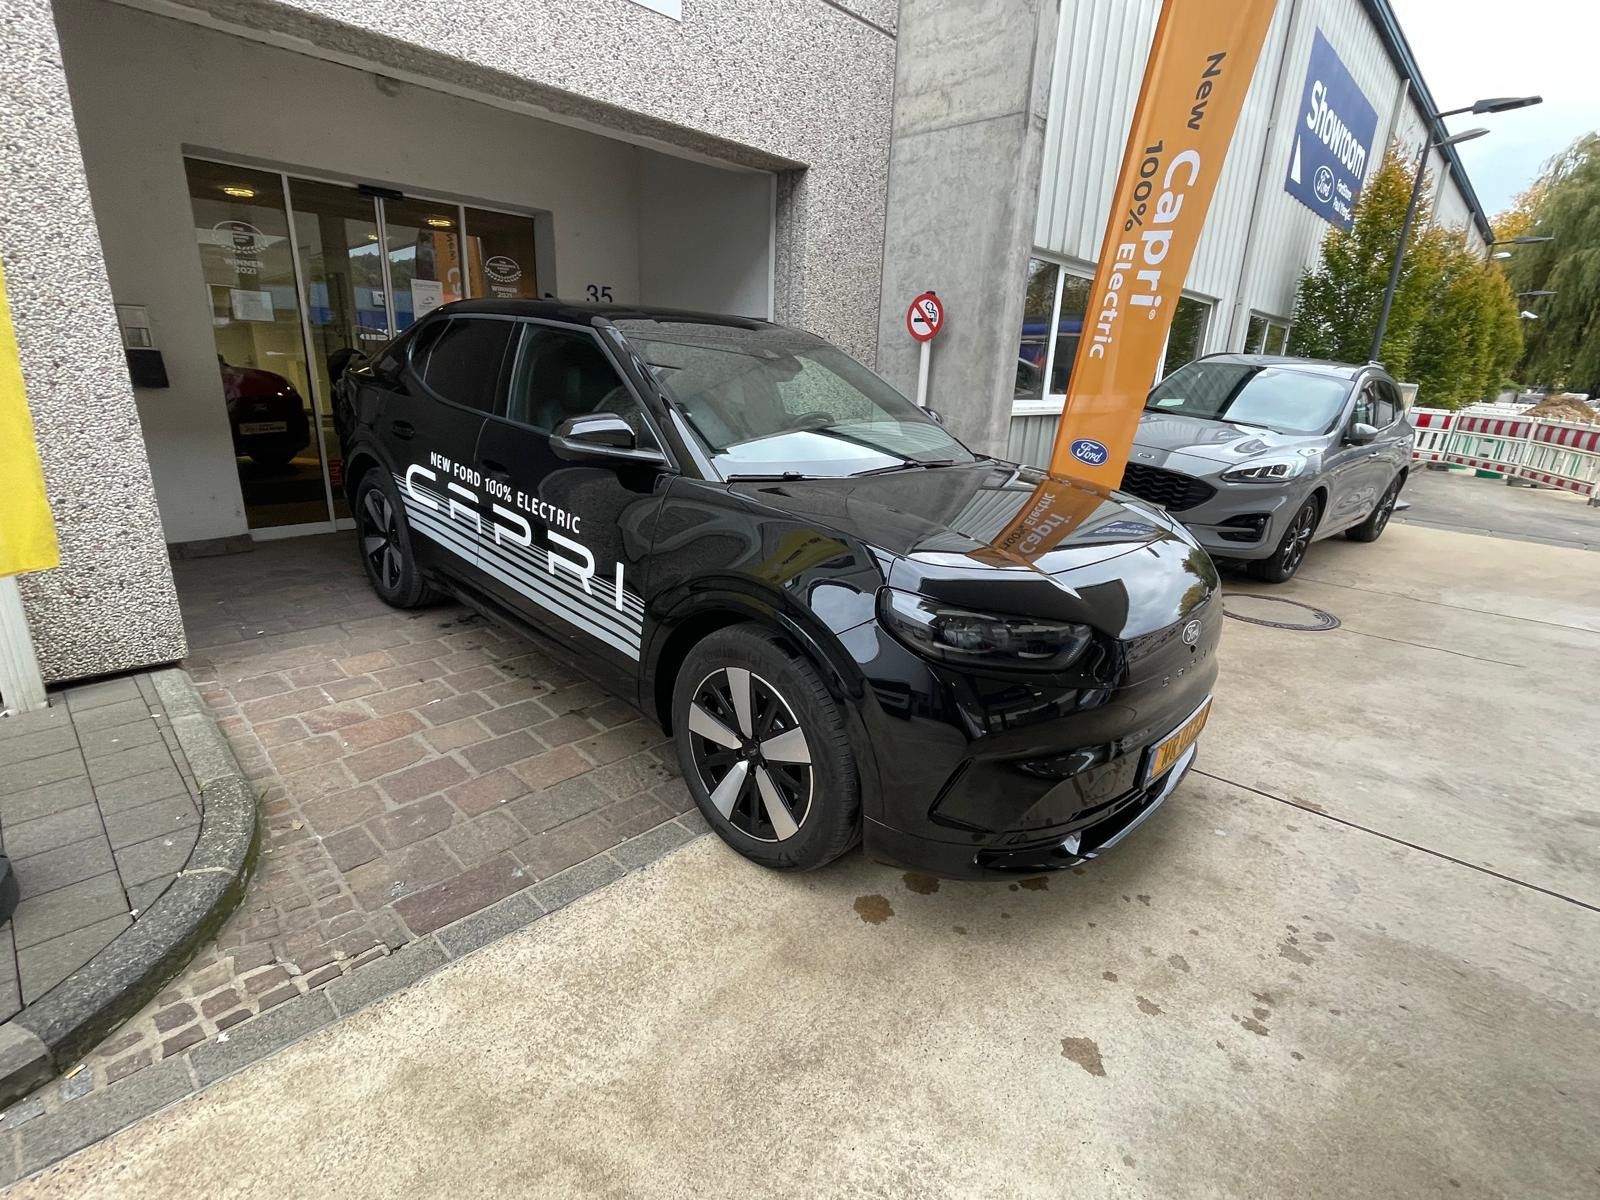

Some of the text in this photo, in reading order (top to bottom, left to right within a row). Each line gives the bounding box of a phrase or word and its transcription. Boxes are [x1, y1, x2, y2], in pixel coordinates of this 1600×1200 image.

[1187, 51, 1227, 131] New
[1306, 79, 1366, 180] Showroom
[224, 257, 264, 269] WINNER
[1089, 139, 1163, 361] 100% Electric
[586, 284, 613, 303] 35
[430, 451, 581, 534] NEW FORD 100% ELECTRIC
[1073, 440, 1104, 465] Ford
[406, 463, 624, 612] CAPRI
